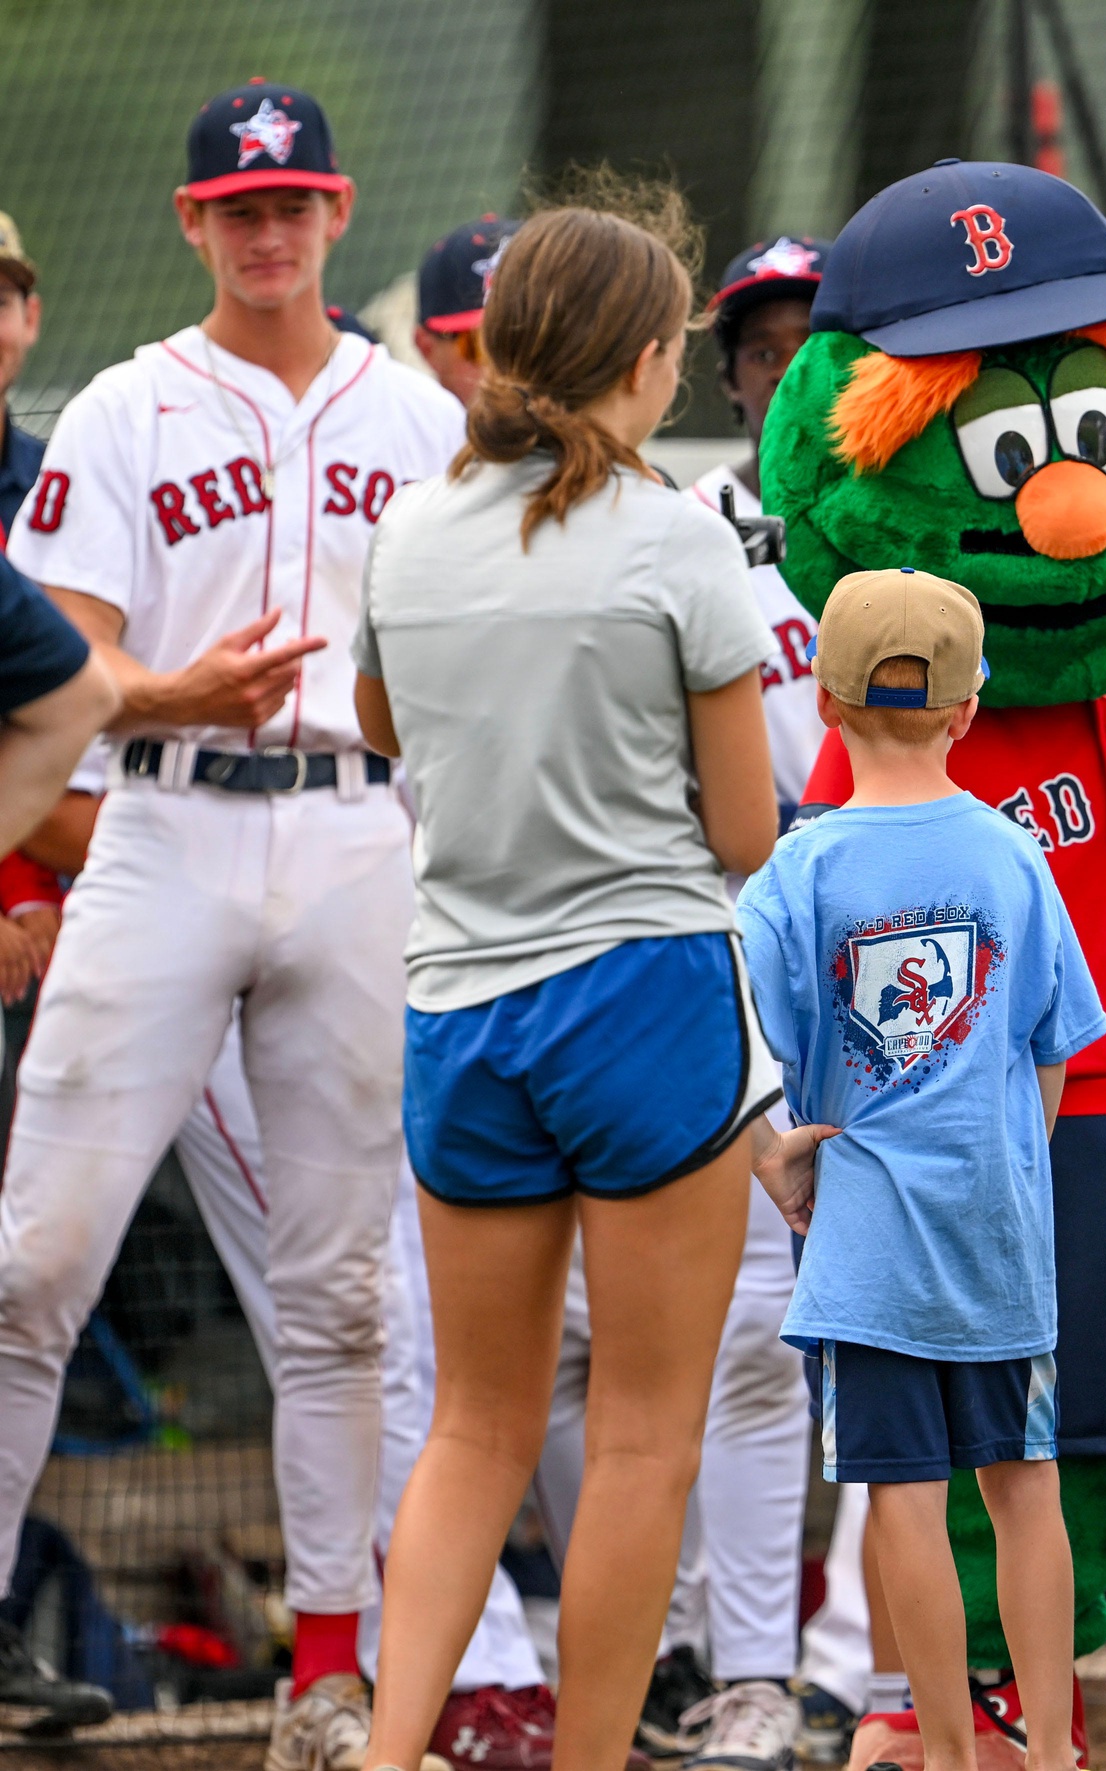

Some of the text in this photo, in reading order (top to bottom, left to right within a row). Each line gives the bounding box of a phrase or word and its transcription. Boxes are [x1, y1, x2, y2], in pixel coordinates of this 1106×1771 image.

[950, 204, 1015, 277] B
[150, 456, 408, 546] RED SO
[997, 772, 1096, 852] ED
[854, 905, 971, 933] Y-D RED SOX
